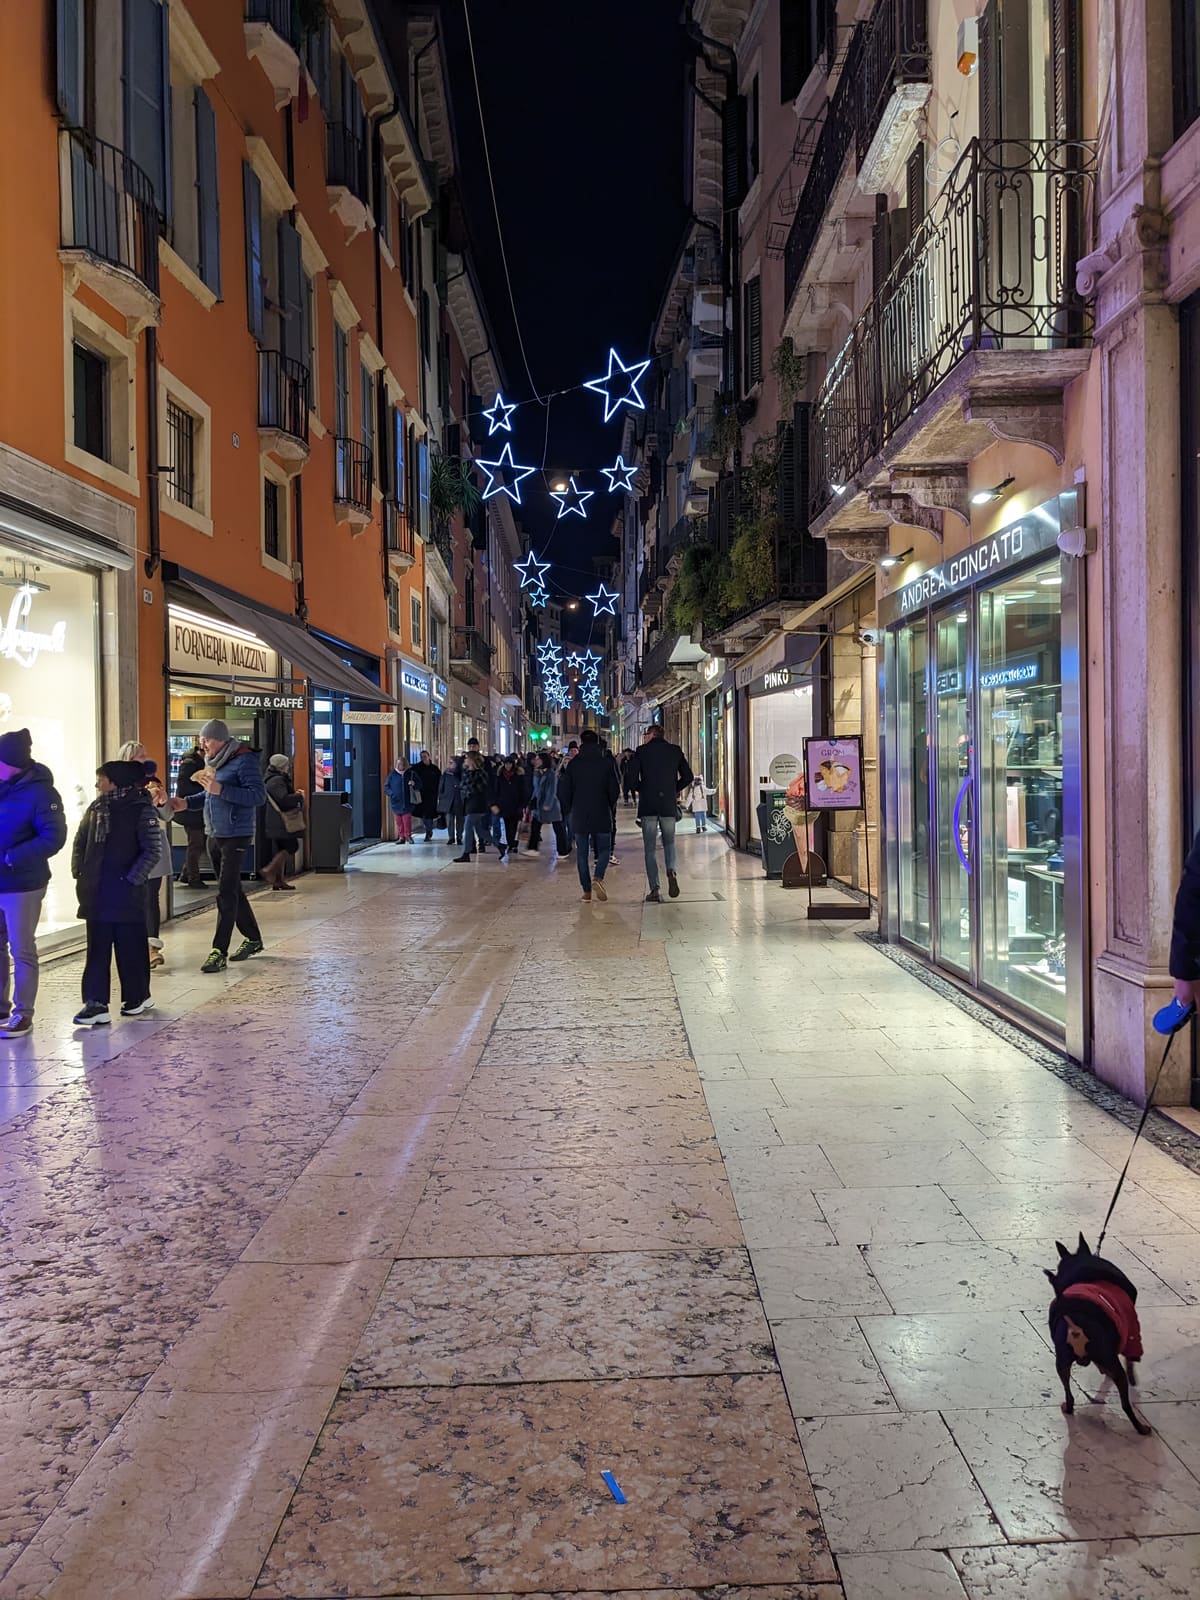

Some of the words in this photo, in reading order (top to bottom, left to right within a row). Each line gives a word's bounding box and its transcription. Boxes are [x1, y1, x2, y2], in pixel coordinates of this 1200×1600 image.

[901, 570, 946, 611] ANDREA
[950, 526, 1023, 586] CONCATO
[174, 625, 228, 666] FORNERIA
[231, 641, 267, 673] MAZZINI
[764, 668, 789, 689] PINKO
[234, 695, 261, 707] PIZZA
[263, 697, 271, 707] &
[273, 696, 304, 709] CAFFÉ
